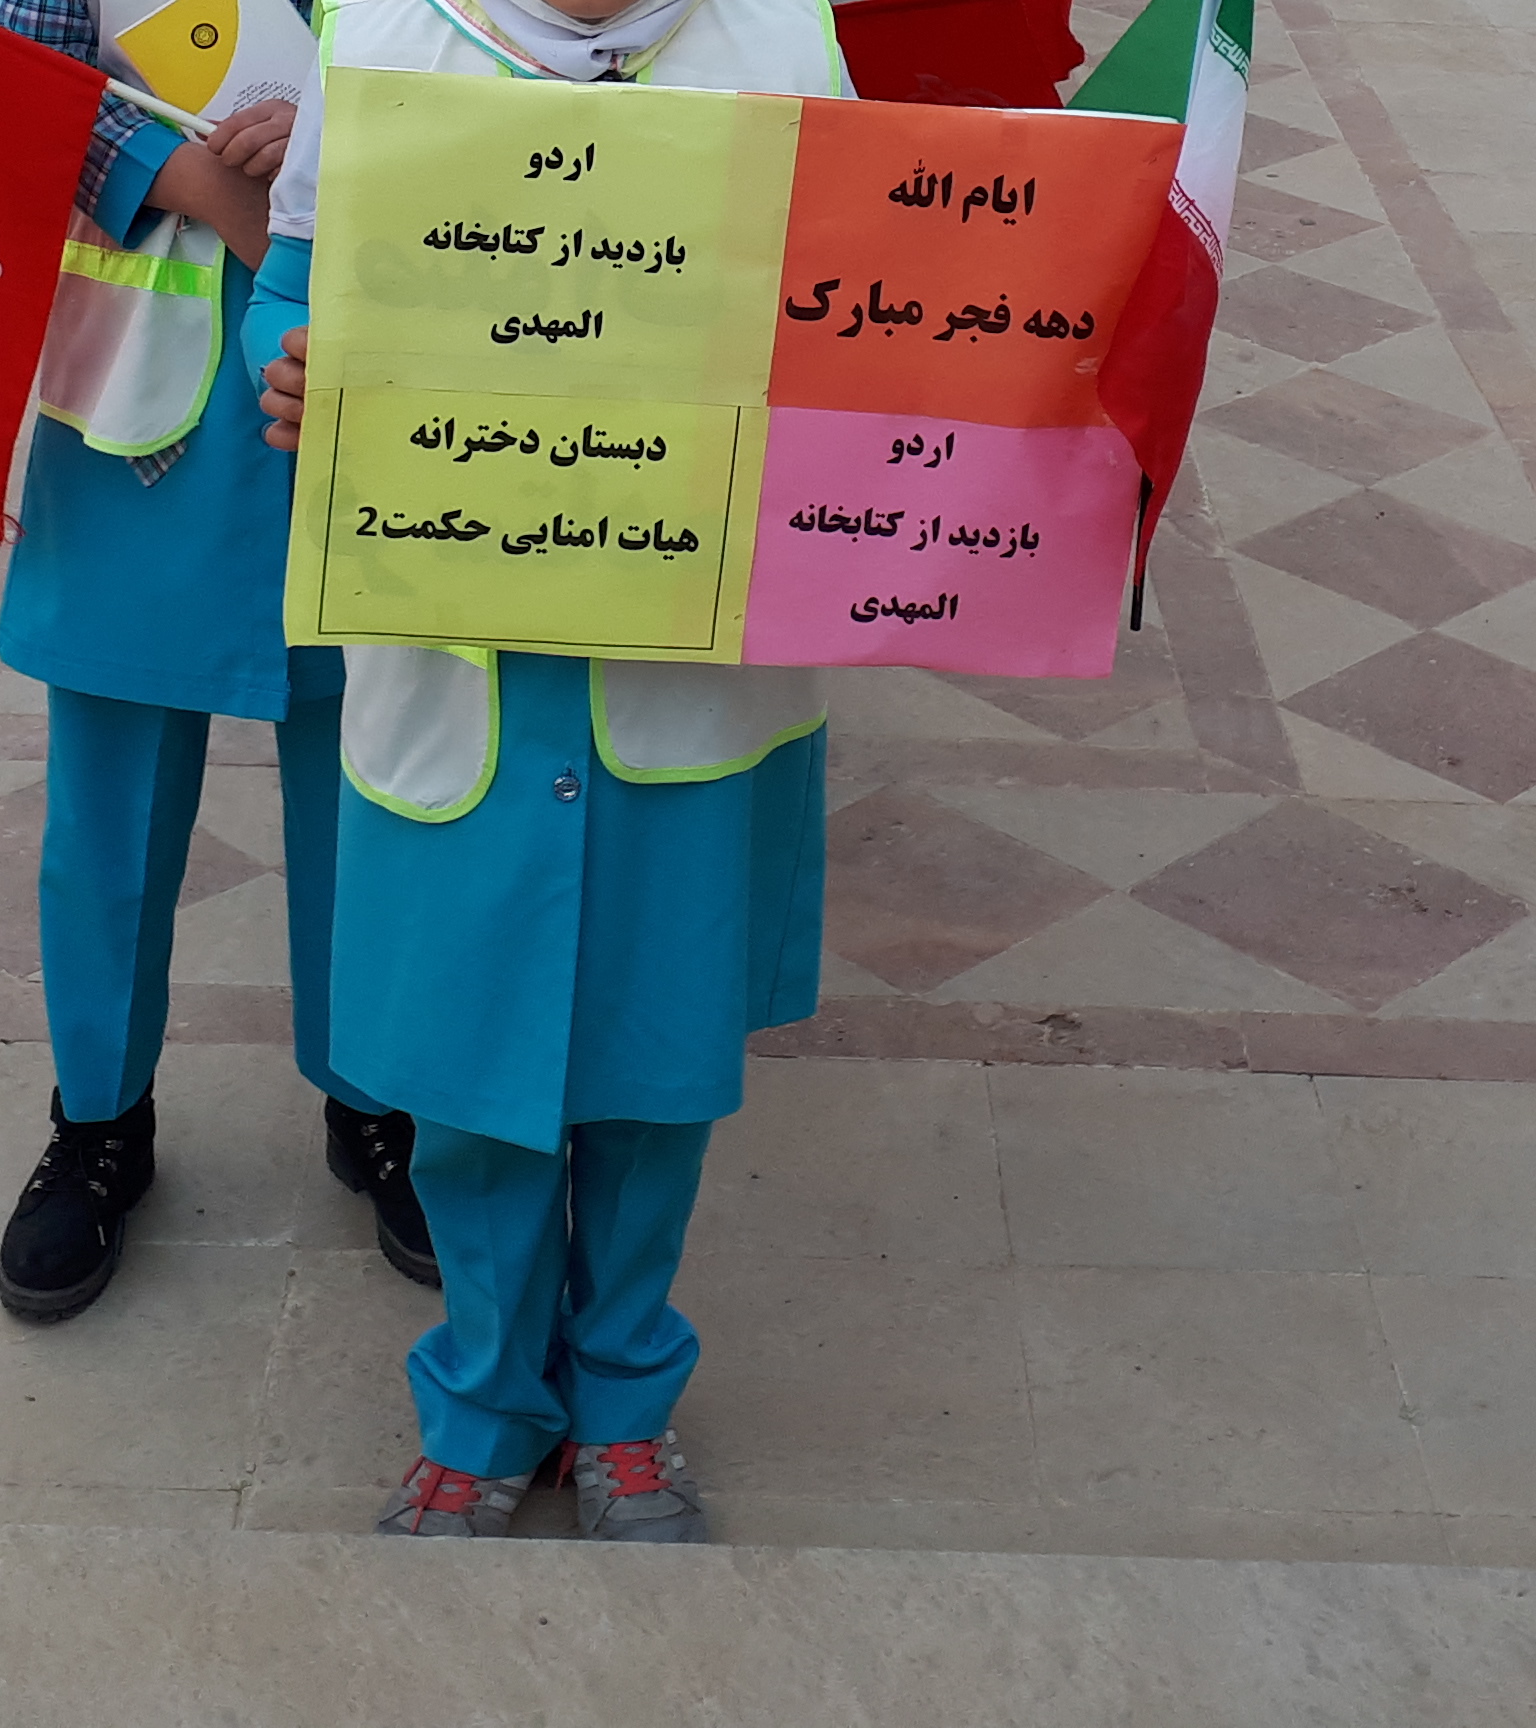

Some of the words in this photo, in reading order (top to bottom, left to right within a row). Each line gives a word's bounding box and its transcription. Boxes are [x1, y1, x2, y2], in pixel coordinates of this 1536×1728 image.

[523, 142, 595, 182] اردو
[887, 159, 953, 209] الله
[961, 174, 1036, 226] ایام
[422, 220, 546, 261] کتابخانه
[550, 228, 583, 267] از
[590, 235, 686, 274] بازدید
[490, 309, 603, 345] المهدی
[785, 278, 924, 338] مبارک
[932, 293, 1011, 343] فجر
[1023, 309, 1095, 340] دهه
[409, 416, 540, 462] دخترانه
[549, 424, 667, 469] دبستان
[886, 432, 955, 469] اردو
[501, 512, 609, 556] امنایی
[617, 518, 700, 561] هیات
[788, 504, 905, 543] کتابخانه
[909, 515, 941, 552] از
[948, 523, 1040, 559] بازدید
[850, 592, 959, 625] المهدی
